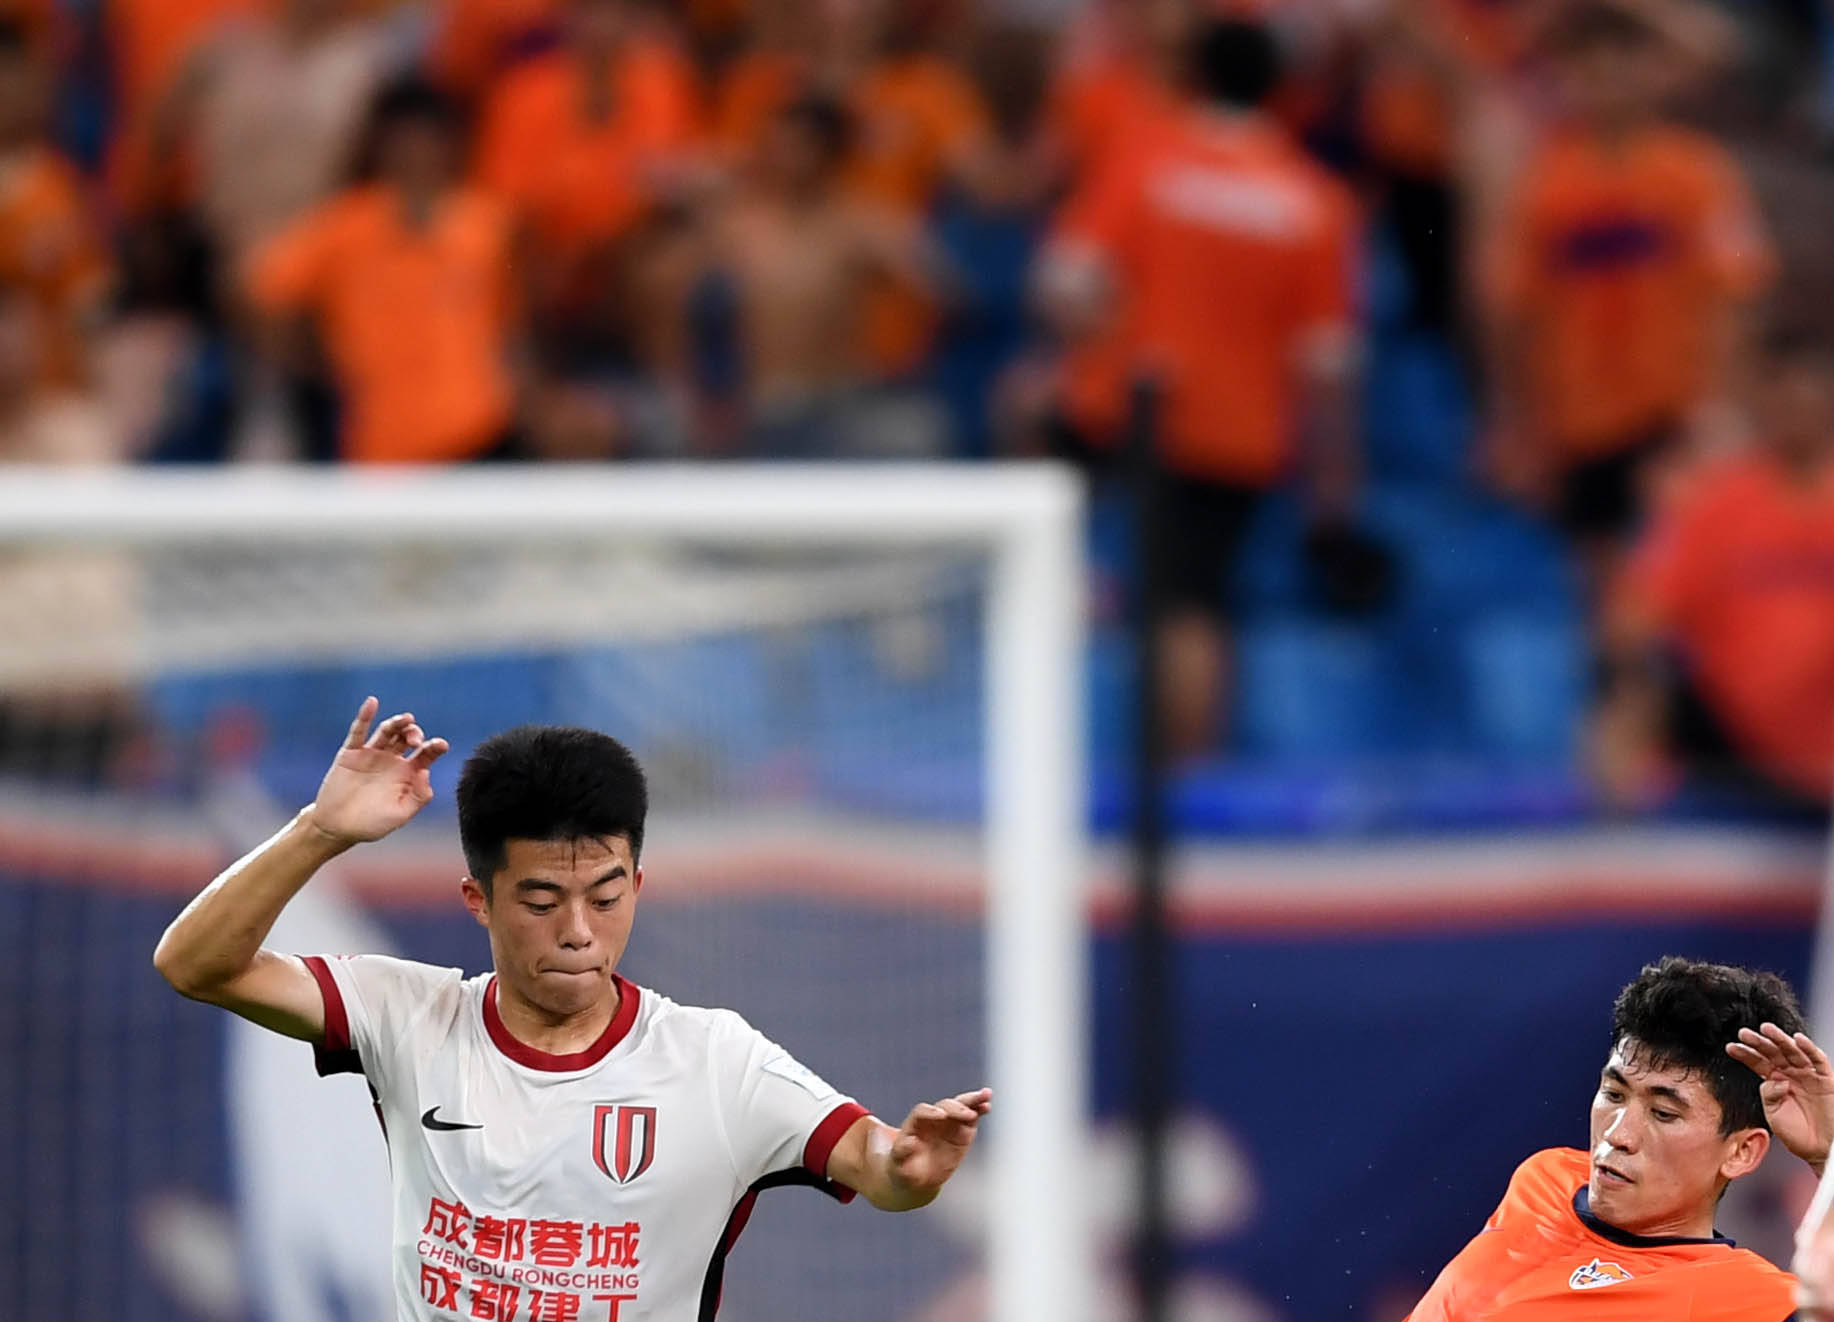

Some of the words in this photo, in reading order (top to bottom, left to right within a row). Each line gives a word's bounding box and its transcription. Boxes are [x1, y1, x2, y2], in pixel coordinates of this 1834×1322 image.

[422, 1197, 641, 1269] 成都蓉城
[416, 1240, 506, 1279] CHENGDU
[512, 1268, 640, 1290] RONGCHENG
